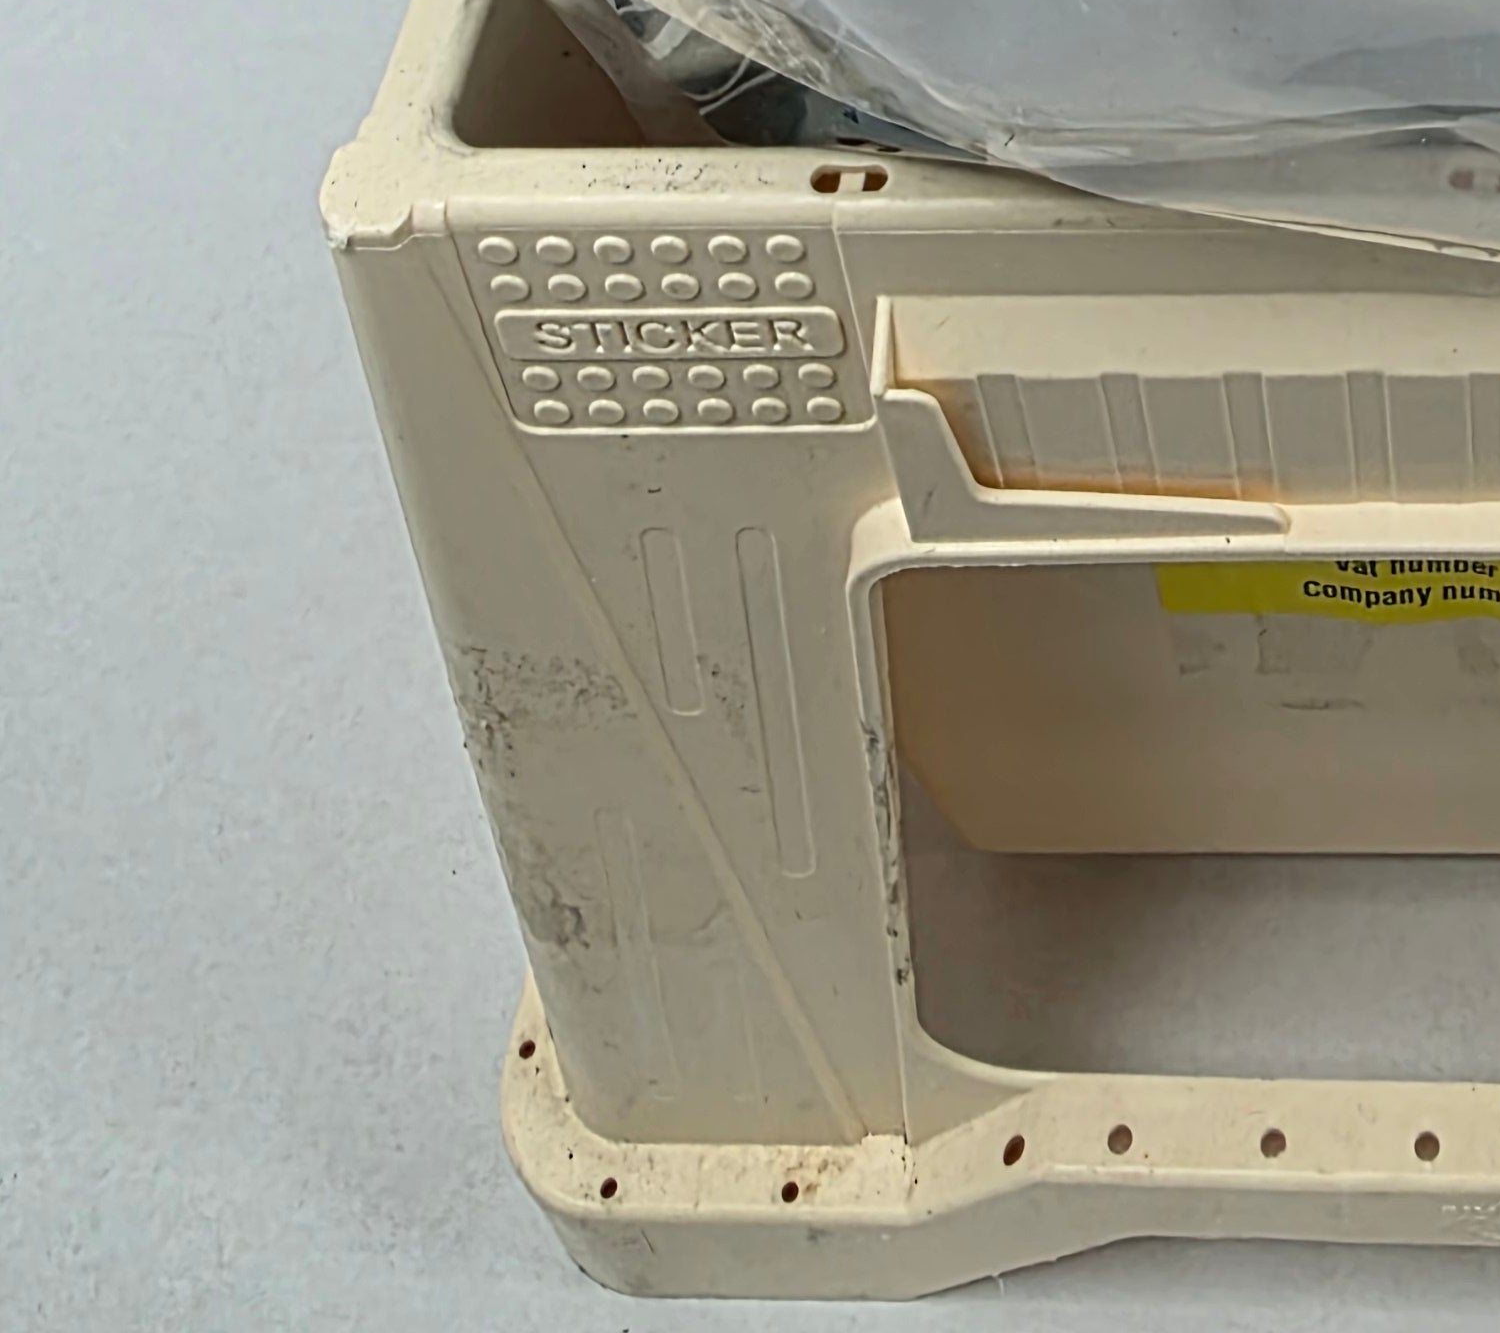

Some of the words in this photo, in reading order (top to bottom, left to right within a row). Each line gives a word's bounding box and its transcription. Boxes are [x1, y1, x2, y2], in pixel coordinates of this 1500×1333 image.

[534, 318, 816, 354] STICKER
[1390, 560, 1499, 579] number
[1303, 580, 1431, 609] Company
